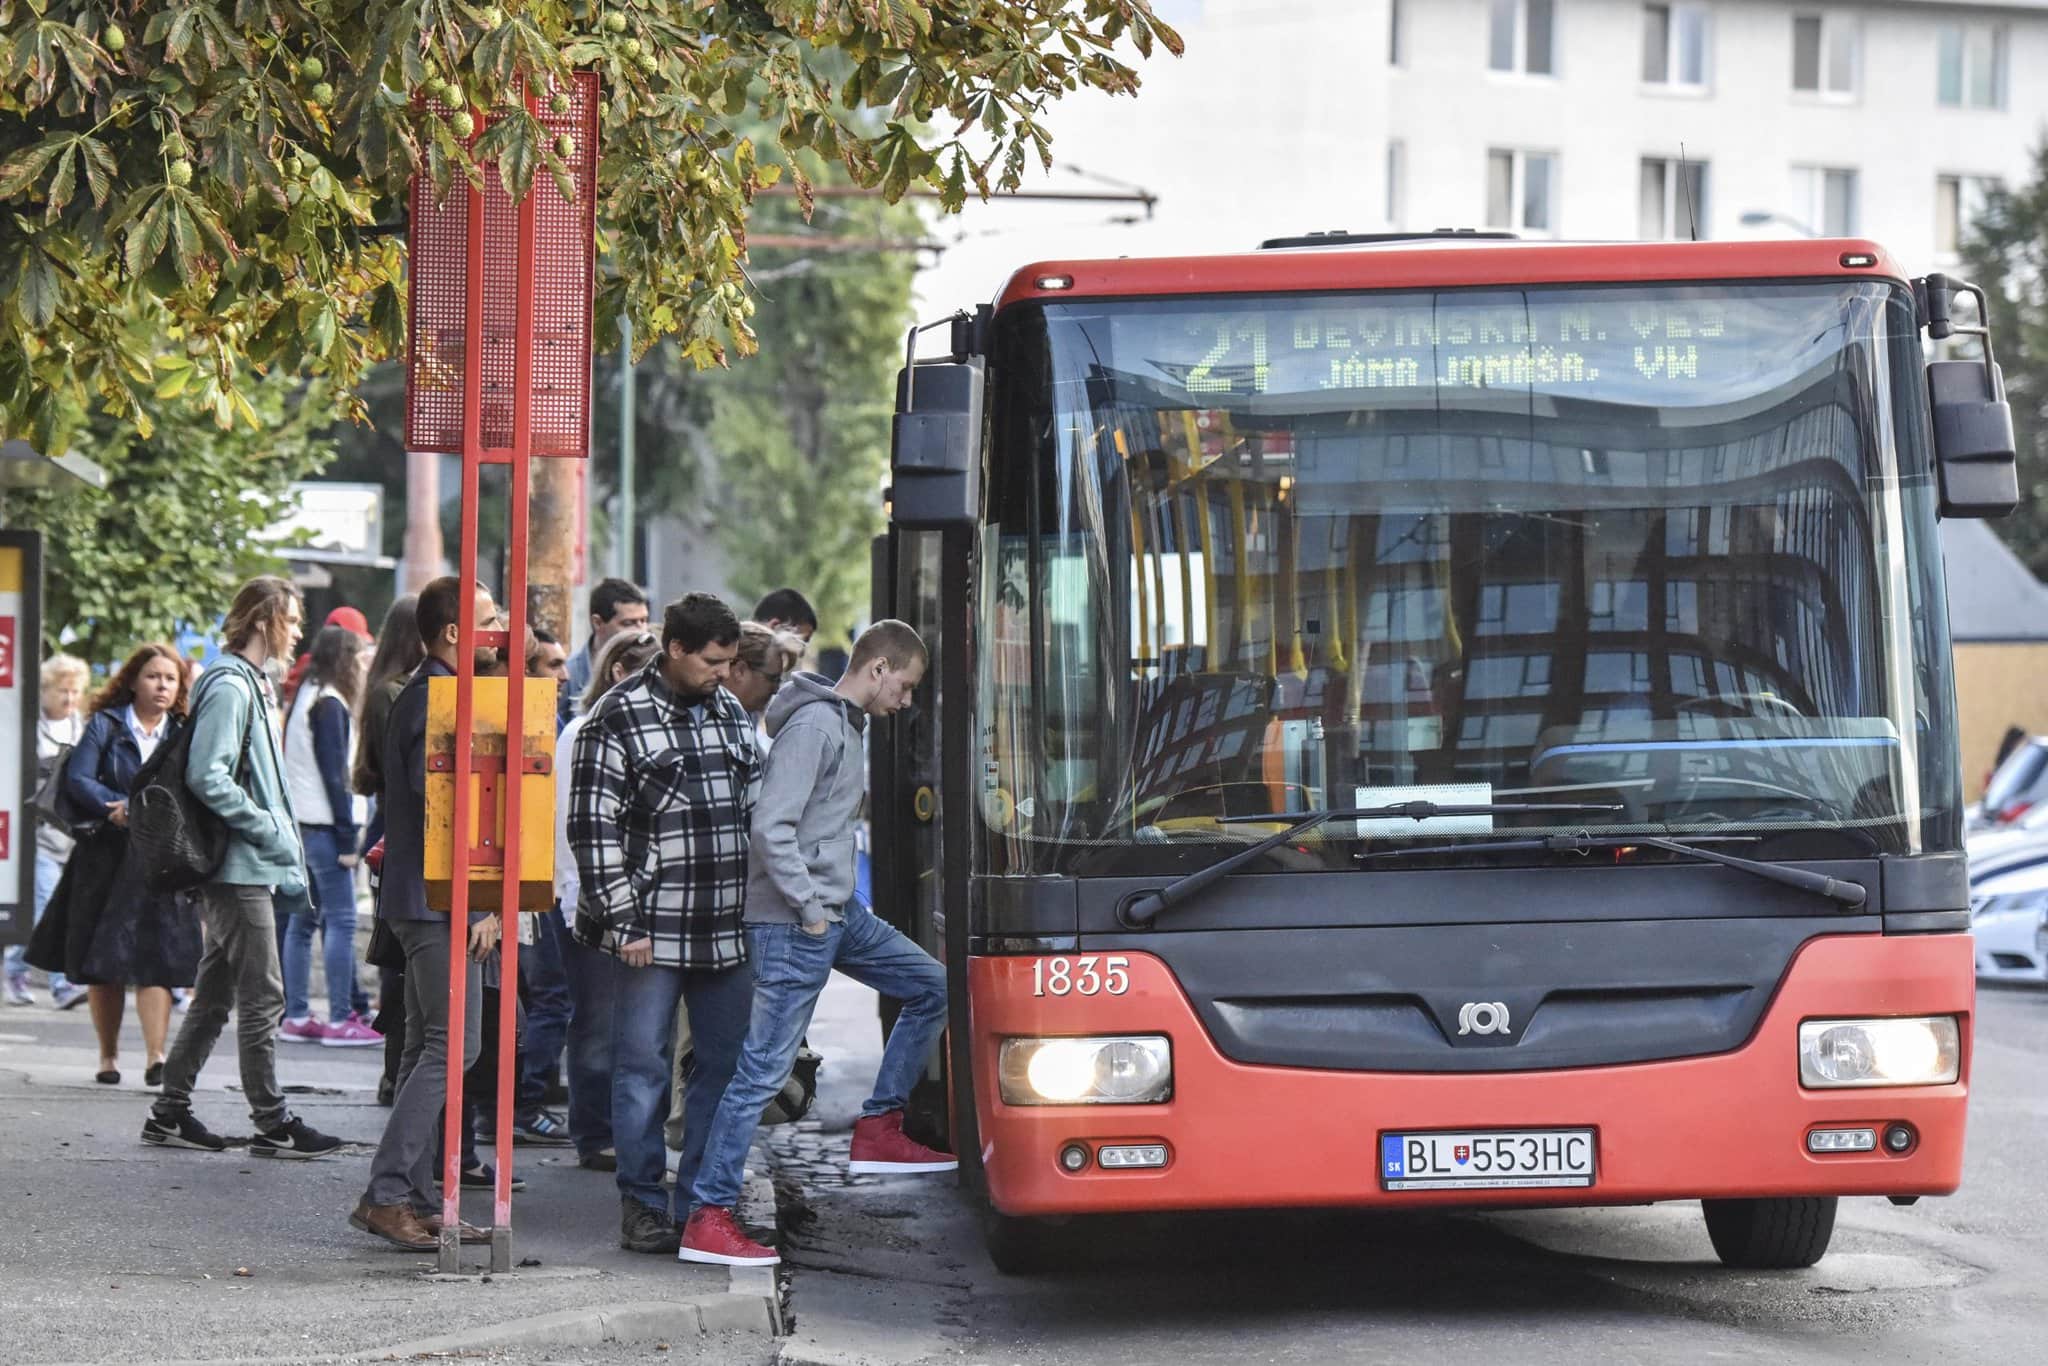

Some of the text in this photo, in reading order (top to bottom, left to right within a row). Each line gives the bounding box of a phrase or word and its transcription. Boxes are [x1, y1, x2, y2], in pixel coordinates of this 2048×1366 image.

[1185, 315, 1269, 393] 21
[1634, 345, 1698, 379] VW
[1032, 956, 1130, 997] 1835
[1388, 1162, 1401, 1172] SK
